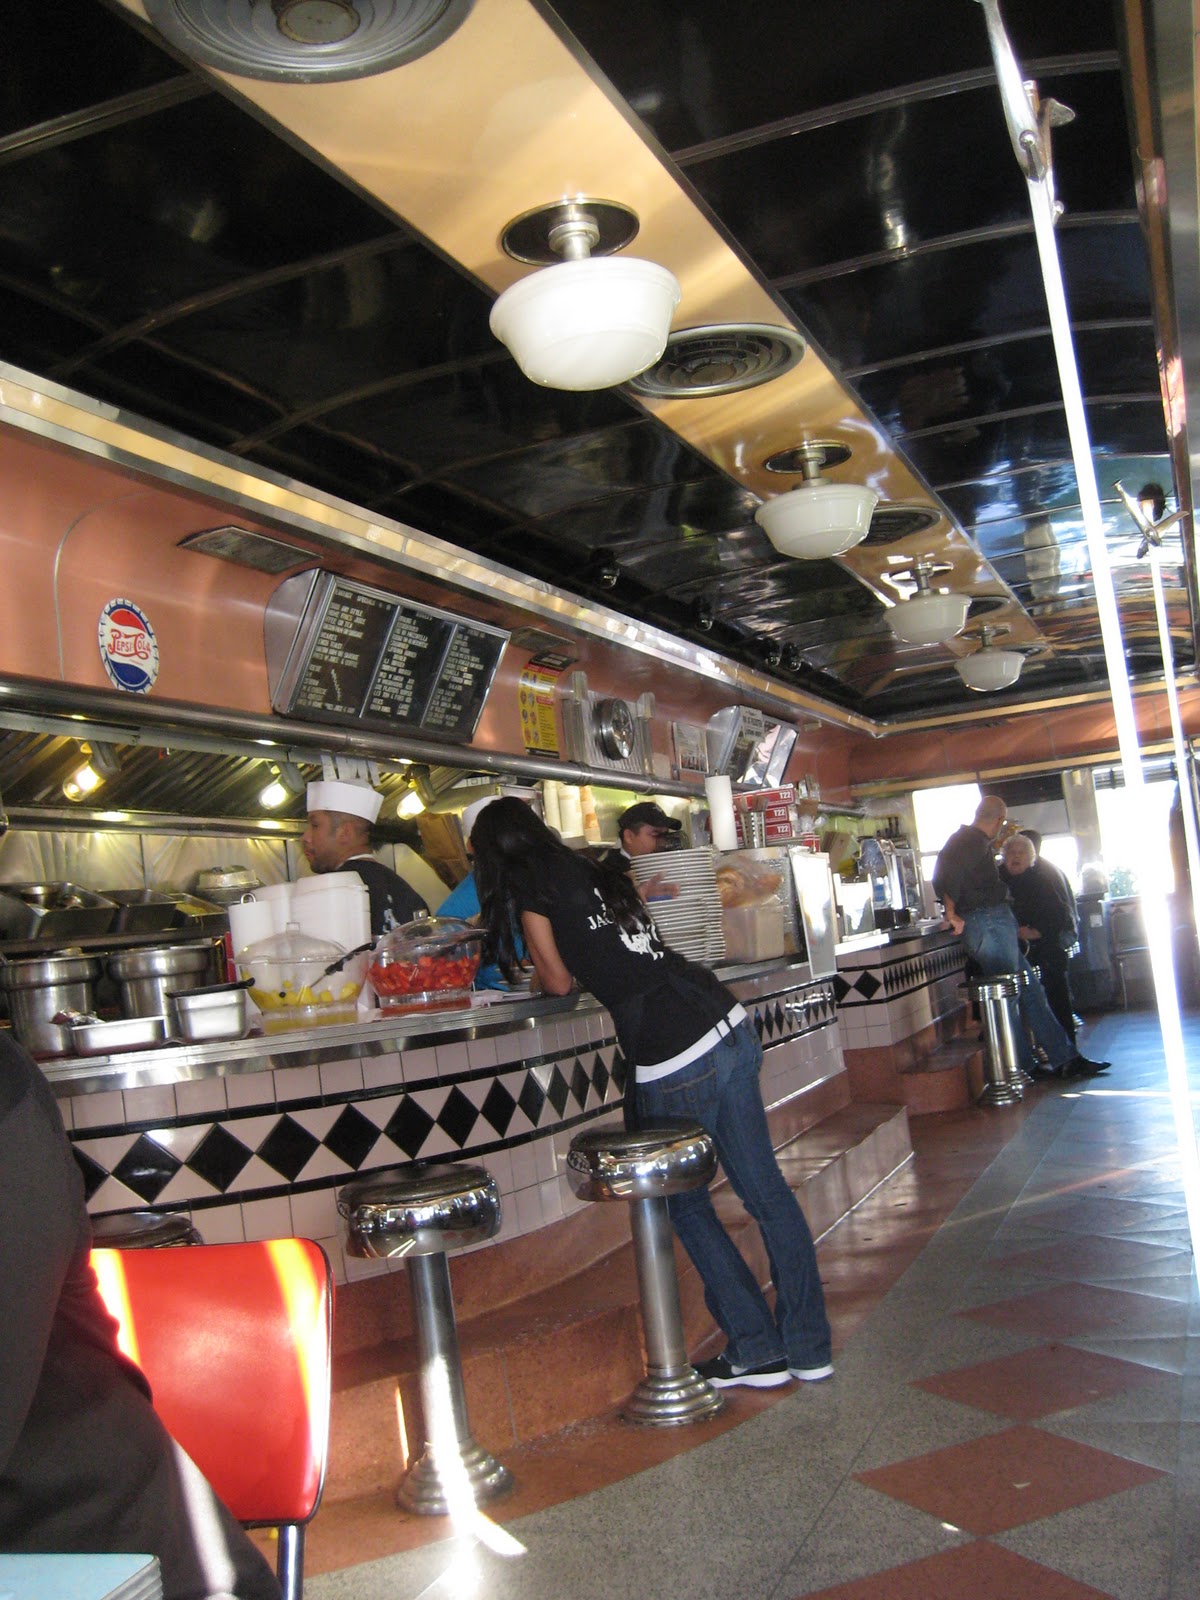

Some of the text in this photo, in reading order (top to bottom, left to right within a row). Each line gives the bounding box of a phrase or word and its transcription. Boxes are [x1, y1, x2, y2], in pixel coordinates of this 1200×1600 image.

[779, 791, 791, 799] T22
[773, 808, 785, 817] T22
[777, 825, 789, 833] T22
